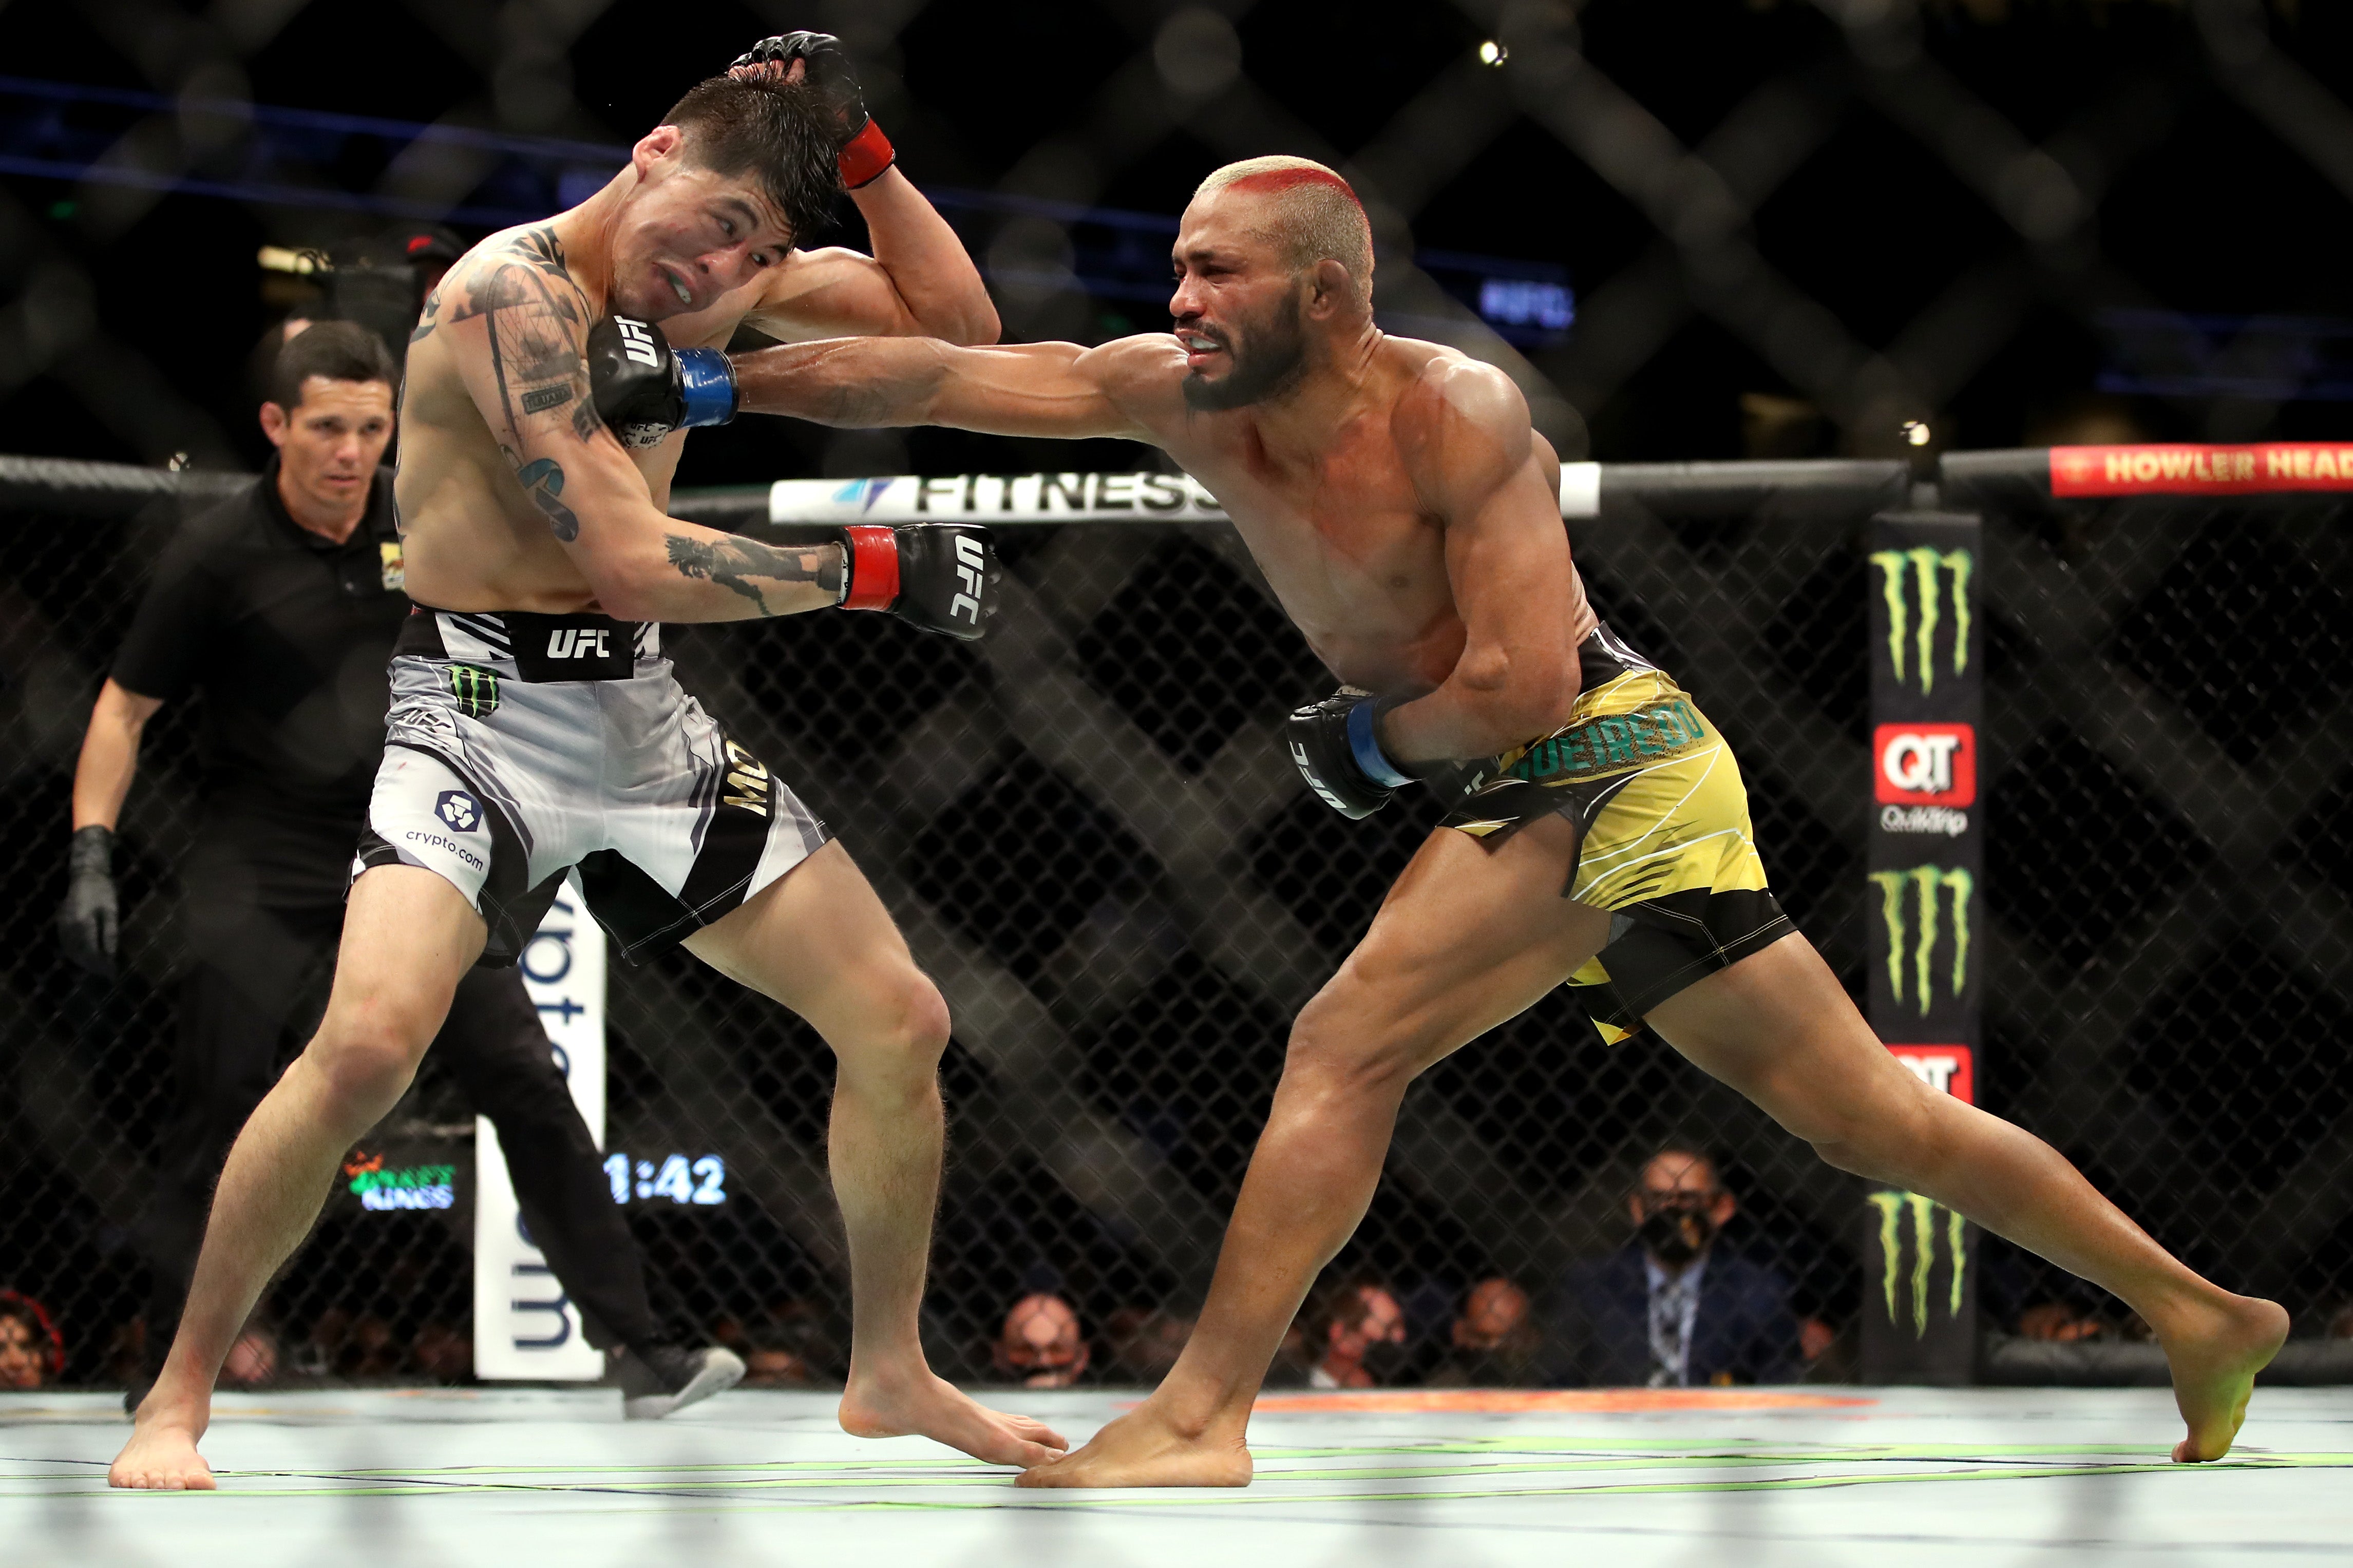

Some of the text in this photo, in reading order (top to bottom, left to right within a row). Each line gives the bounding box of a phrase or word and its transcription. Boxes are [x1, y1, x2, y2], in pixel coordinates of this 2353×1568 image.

[2105, 452, 2255, 483] HOWLER
[916, 472, 1221, 510] FITNES
[950, 534, 983, 625] UFC
[547, 629, 610, 659] UFC
[1289, 740, 1347, 809] UFC
[1883, 734, 1963, 794] QT
[406, 831, 483, 871] crypto.com
[603, 1153, 727, 1205] 1:42
